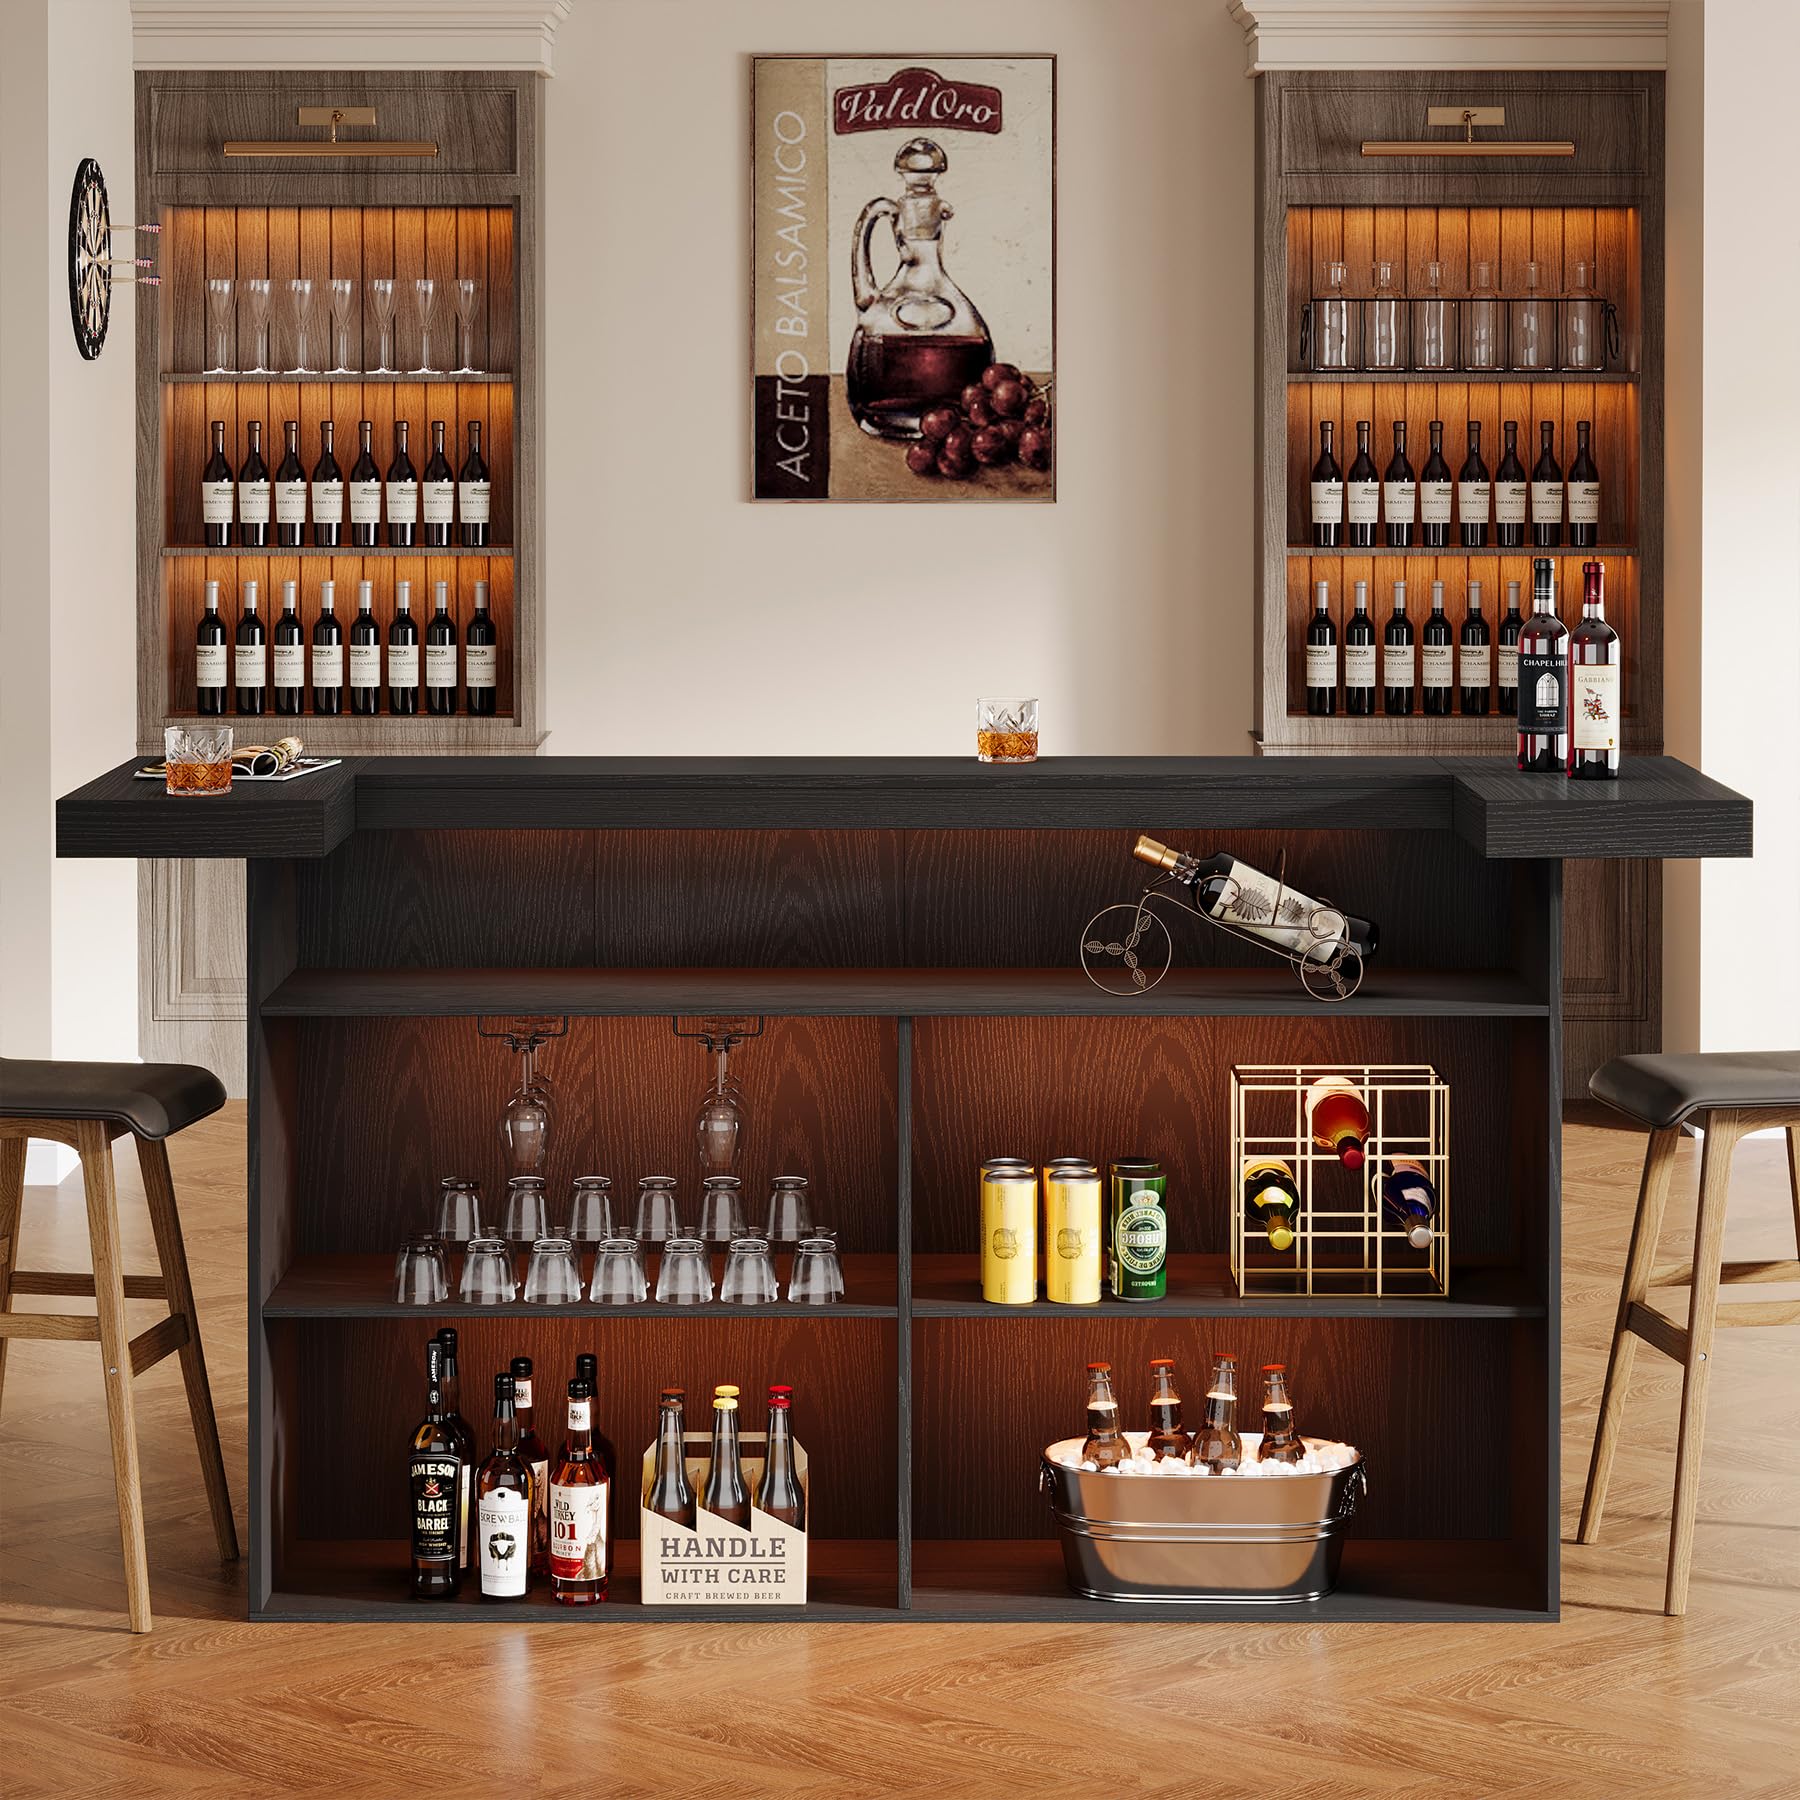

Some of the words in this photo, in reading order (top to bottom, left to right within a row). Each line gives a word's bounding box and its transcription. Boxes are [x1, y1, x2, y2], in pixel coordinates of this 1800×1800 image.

[774, 111, 809, 338] BALSAMICO
[776, 349, 810, 482] ACETO
[1523, 659, 1555, 667] CHAPEL
[411, 1463, 456, 1478] JAMESON
[417, 1499, 448, 1513] BLACK
[416, 1517, 449, 1531] BARREL
[553, 1520, 577, 1541] 101
[660, 1537, 786, 1558] HANDLE
[661, 1568, 720, 1584] WITH
[727, 1568, 786, 1584] CARE
[665, 1592, 701, 1600] CRAFT
[705, 1592, 750, 1600] BREWED
[754, 1592, 782, 1600] BEER
